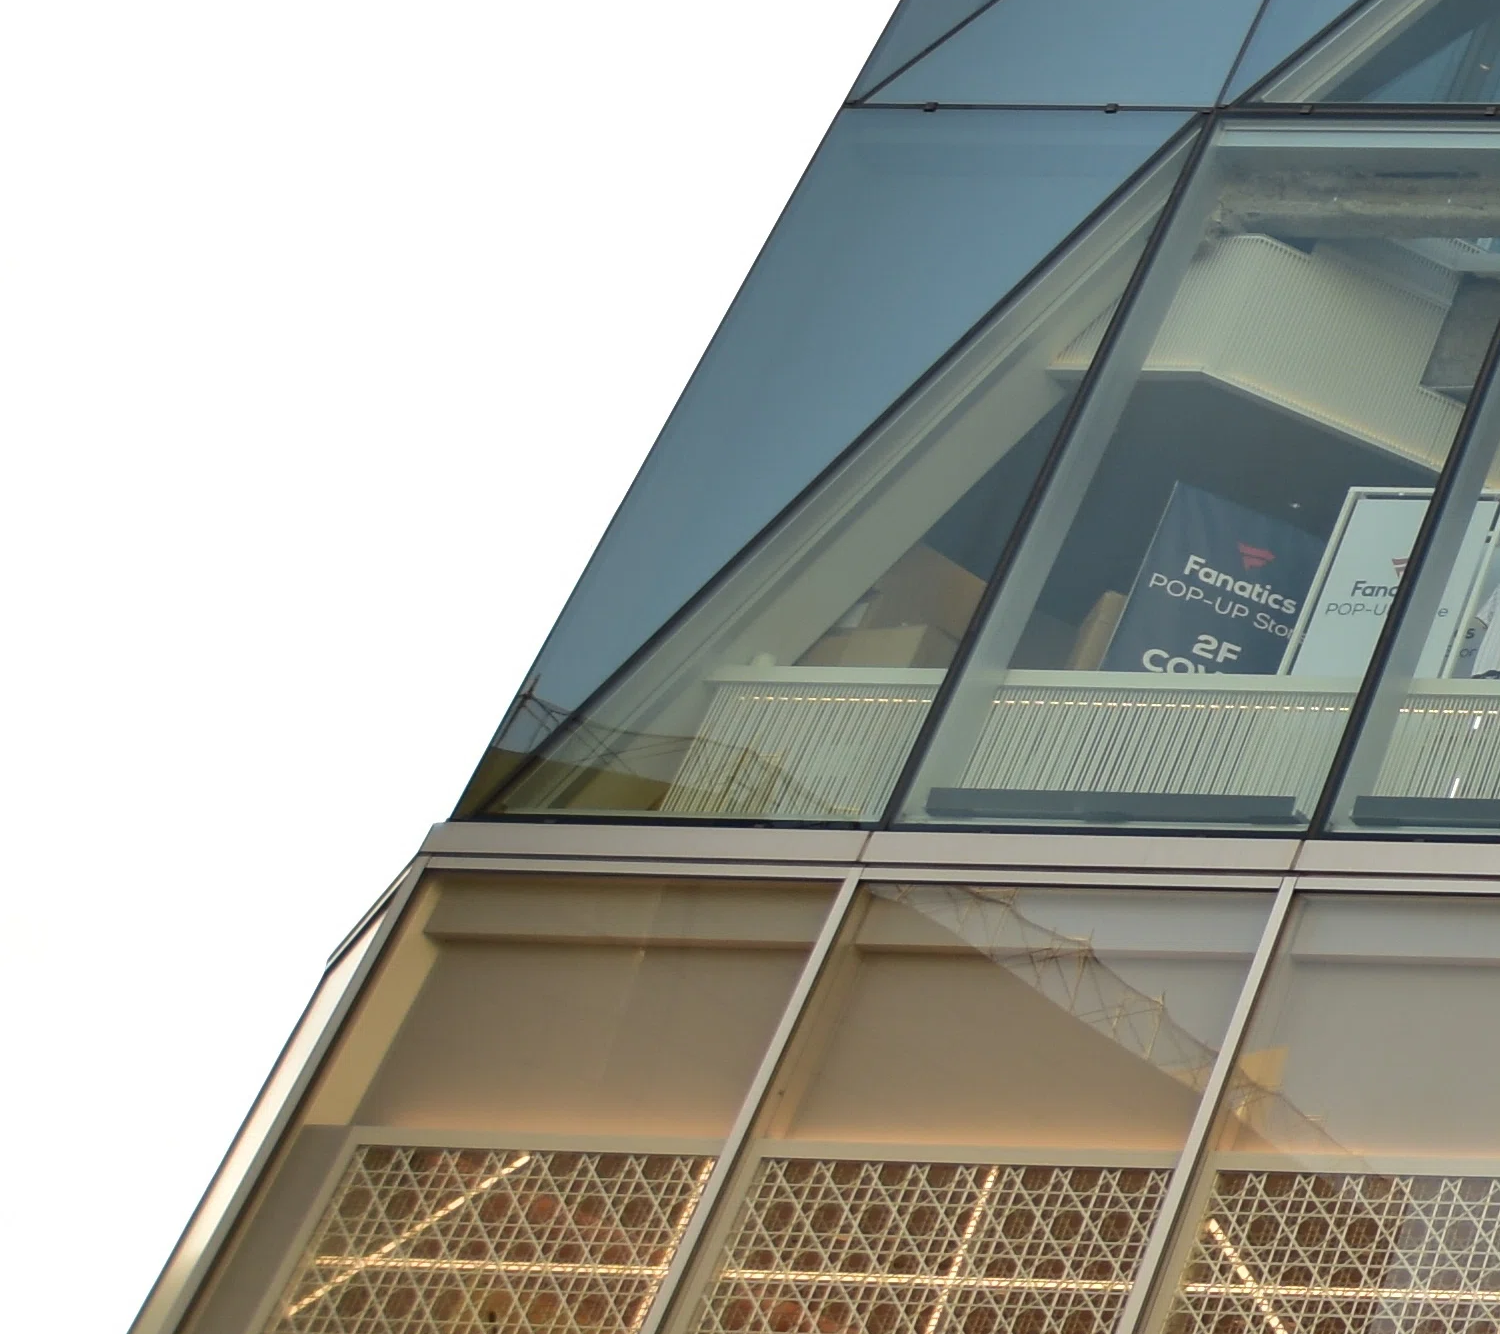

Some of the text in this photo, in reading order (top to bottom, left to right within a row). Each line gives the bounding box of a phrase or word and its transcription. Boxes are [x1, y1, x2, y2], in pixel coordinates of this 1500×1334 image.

[1183, 554, 1297, 614] Fanatics
[1149, 572, 1306, 644] POP-UP Stor
[1325, 602, 1390, 616] POP-U
[1192, 634, 1242, 663] 2F
